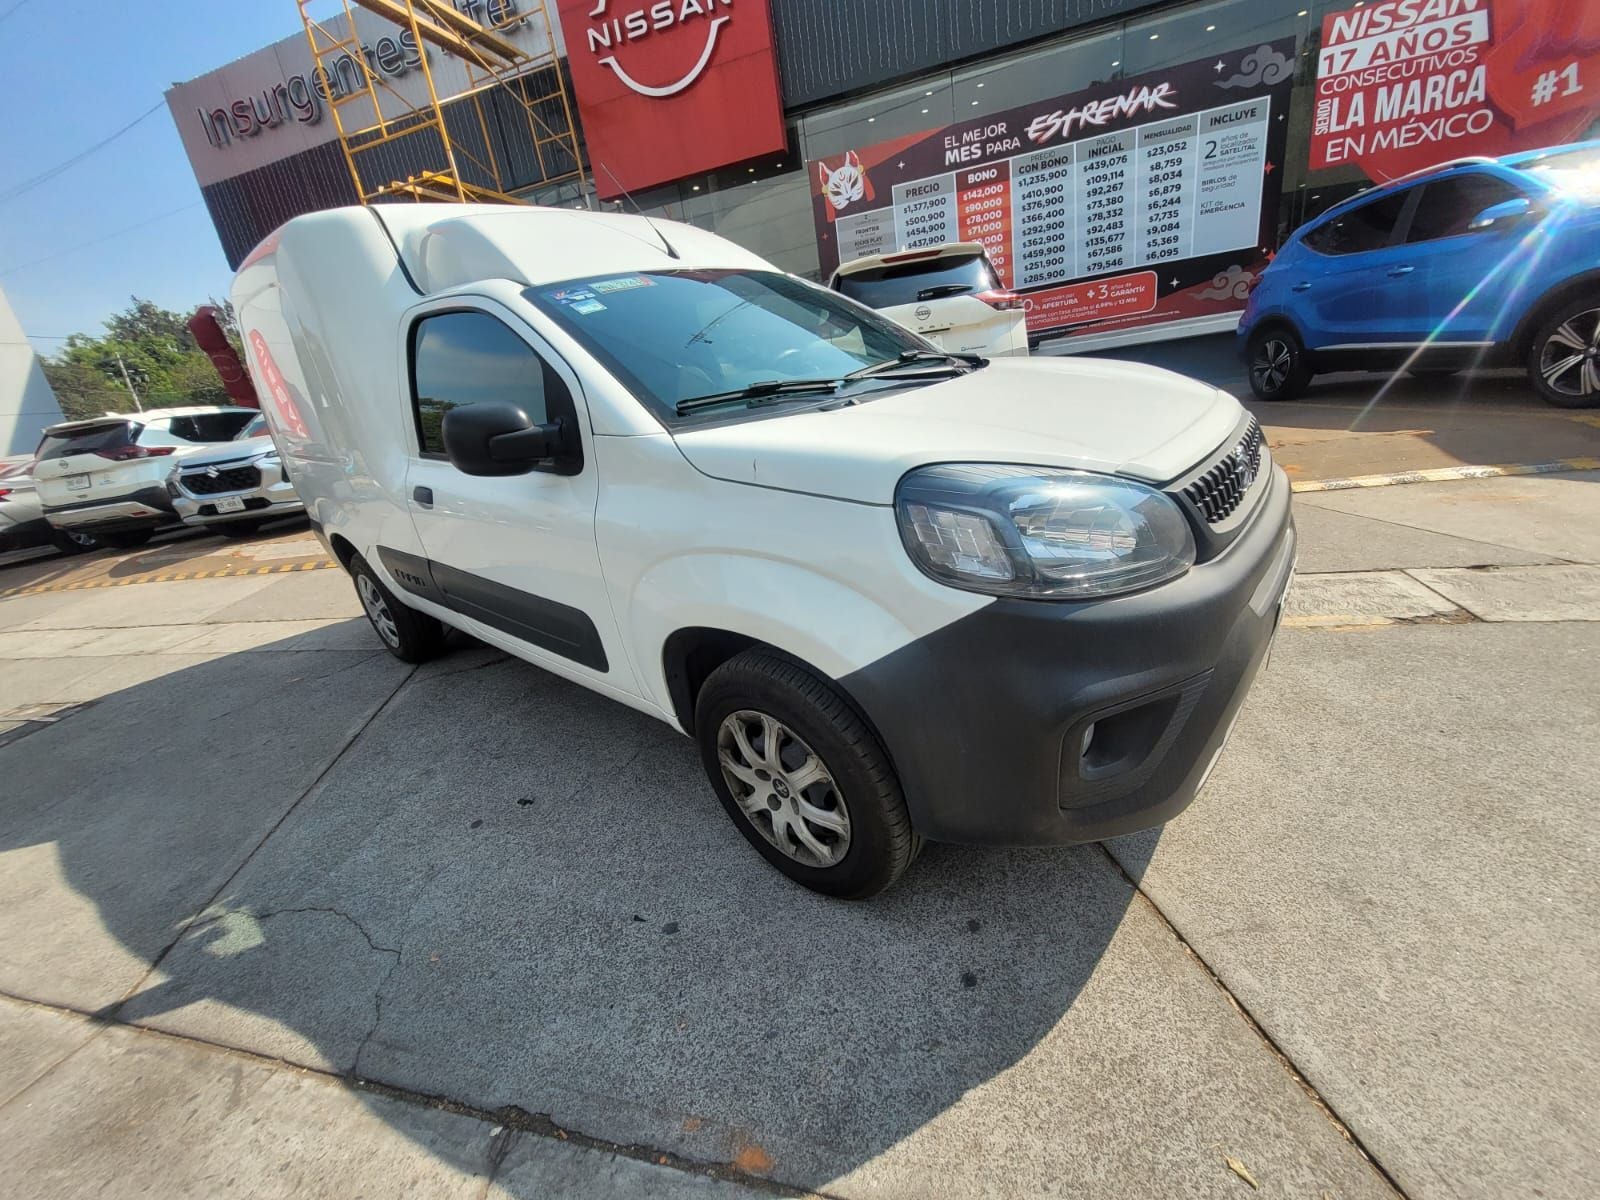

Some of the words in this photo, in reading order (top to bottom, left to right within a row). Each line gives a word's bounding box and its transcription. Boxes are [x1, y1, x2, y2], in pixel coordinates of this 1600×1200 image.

[1323, 47, 1359, 75] 17
[1368, 20, 1473, 66] AÑOS
[1320, 47, 1478, 95] CONSECUTIVOS
[1531, 63, 1583, 107] #1
[1329, 92, 1365, 133] LA
[1374, 65, 1486, 123] MARCA
[1024, 82, 1177, 143] ESTRENAR
[1210, 108, 1257, 127] INCLUYE
[1315, 99, 1331, 136] SIENDO
[944, 135, 960, 149] EL
[962, 122, 1007, 145] MEJOR
[1096, 135, 1116, 146] PAGO
[1143, 125, 1192, 140] MENSUALIDAD
[1325, 134, 1365, 162] EN
[1370, 109, 1494, 154] MÉXICO
[945, 143, 982, 166] MES
[986, 137, 1021, 156] PARA
[1030, 151, 1056, 162] PRECIO
[1088, 143, 1125, 158] INICIAL
[1147, 141, 1188, 158] $23,052
[1204, 140, 1217, 160] 2
[1220, 144, 1256, 156] SATELITAL
[1019, 163, 1038, 175] CON
[1041, 156, 1068, 170] BONO
[1083, 155, 1128, 173] $439,076
[1150, 157, 1183, 172] $8,759
[967, 168, 998, 184] BONO
[1018, 169, 1068, 187] $1,235,900
[1086, 170, 1125, 186] $109,114
[1148, 169, 1183, 184] $8,034
[1201, 176, 1227, 187] BIRLOS
[905, 183, 940, 198] PRECIO
[1022, 184, 1064, 200] $410,900
[1086, 182, 1124, 198] $92,267
[1148, 183, 1182, 198] $6,879
[904, 197, 947, 214] $1,377,900
[1022, 195, 1064, 212] $376,900
[1086, 195, 1124, 210] $73,380
[1148, 196, 1181, 211] $6,244
[1200, 200, 1214, 209] KIT
[1215, 199, 1224, 207] de
[1200, 201, 1246, 216] EMERGENCIA
[905, 210, 945, 226] $500,900
[1022, 208, 1065, 224] $366,400
[1087, 208, 1124, 222] $78,332
[1148, 210, 1180, 223] $7,735
[906, 222, 946, 238] $454,900
[1022, 220, 1065, 236] $292,900
[1086, 220, 1124, 235] $92,483
[1146, 222, 1180, 236] $9,084
[908, 234, 946, 249] $437,900
[1022, 233, 1065, 249] $362,900
[1085, 232, 1125, 248] $135,677
[1147, 235, 1179, 248] $5,369
[1022, 244, 1066, 260] $459,900
[1146, 247, 1179, 261] $6,095
[1024, 256, 1064, 271] $251,900
[1086, 258, 1123, 272] $79,546
[1042, 297, 1079, 310] APERTURA
